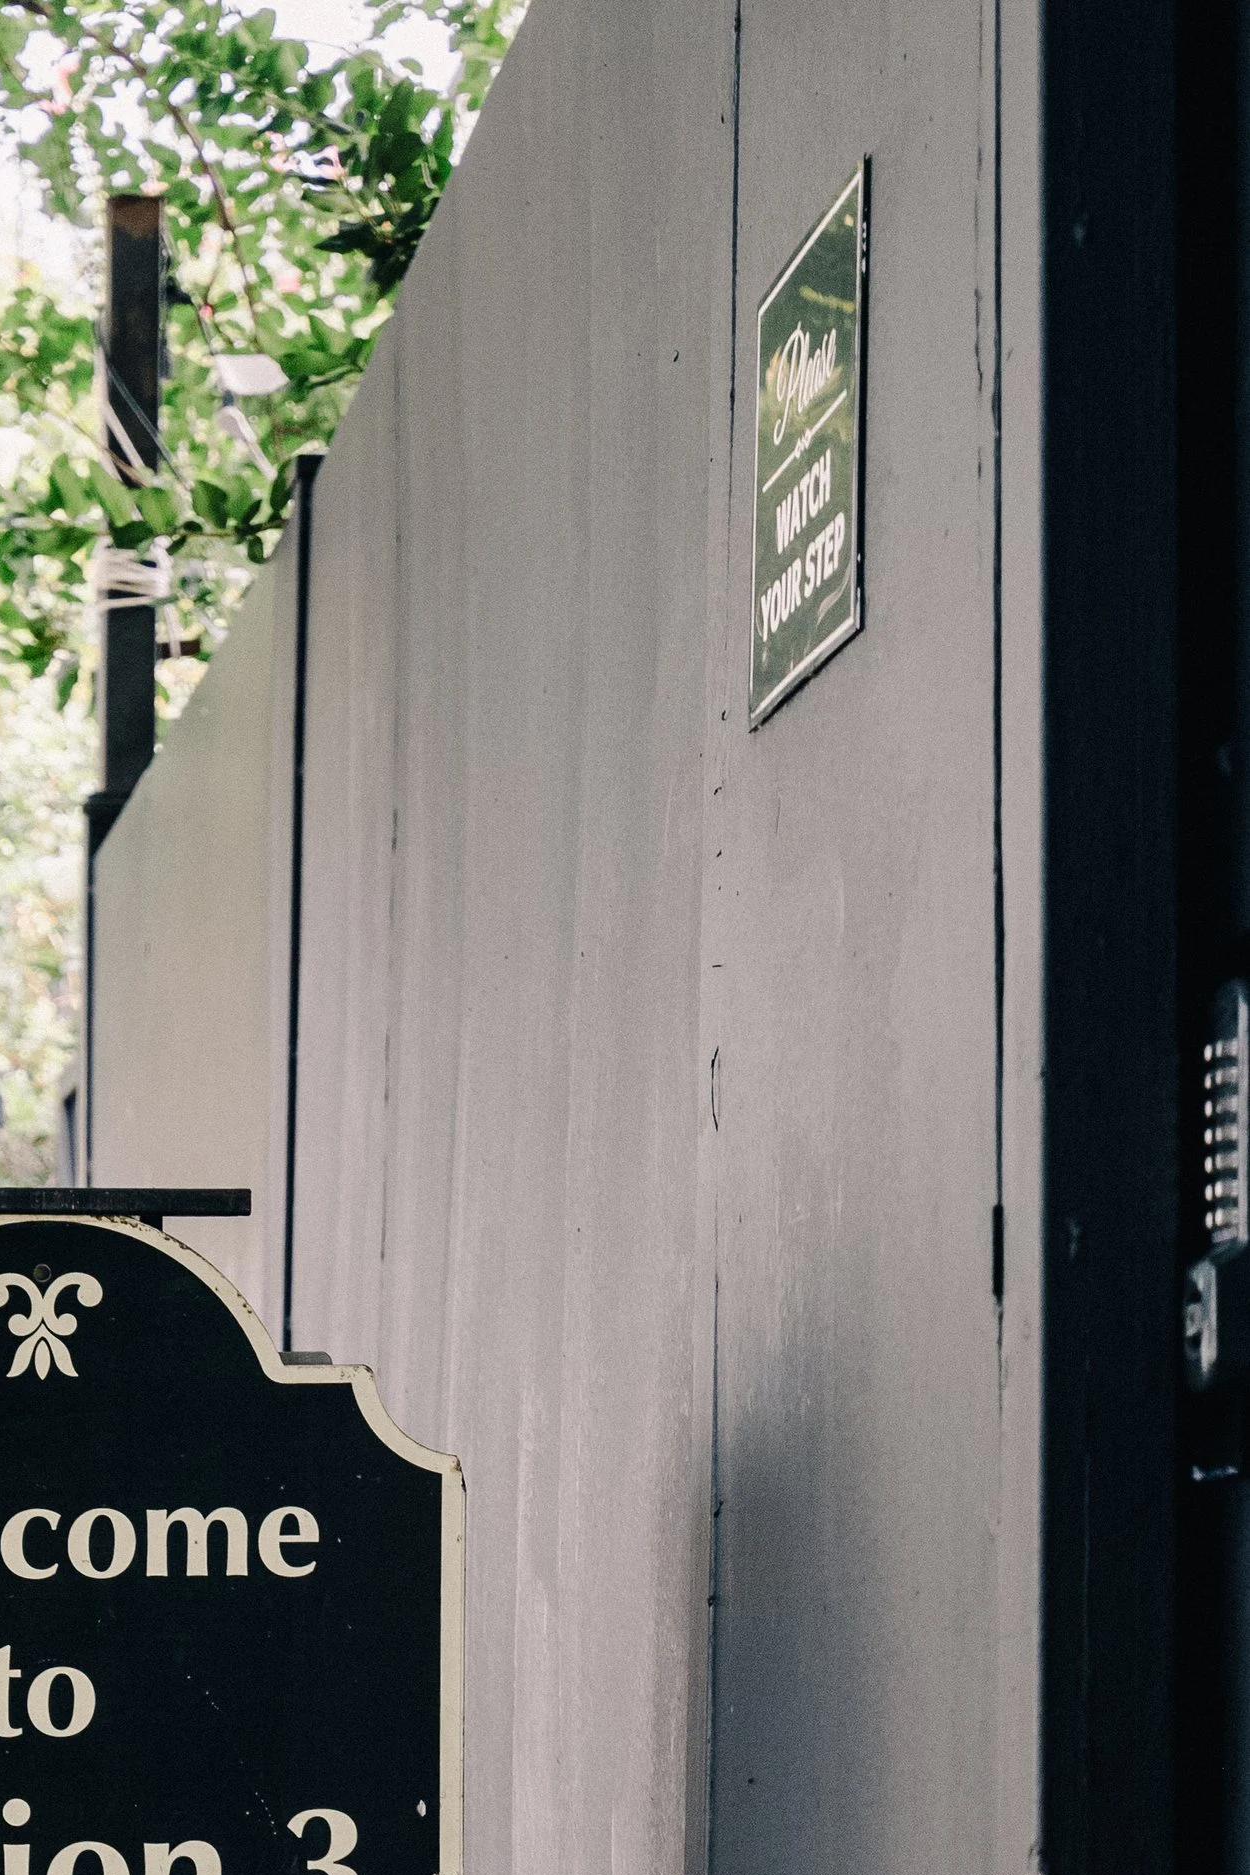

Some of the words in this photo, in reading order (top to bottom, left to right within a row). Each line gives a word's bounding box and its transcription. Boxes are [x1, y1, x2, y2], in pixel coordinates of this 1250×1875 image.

[773, 321, 837, 445] Please
[776, 448, 832, 555] WATCH
[761, 557, 802, 643] YOUR
[804, 511, 846, 599] STEP
